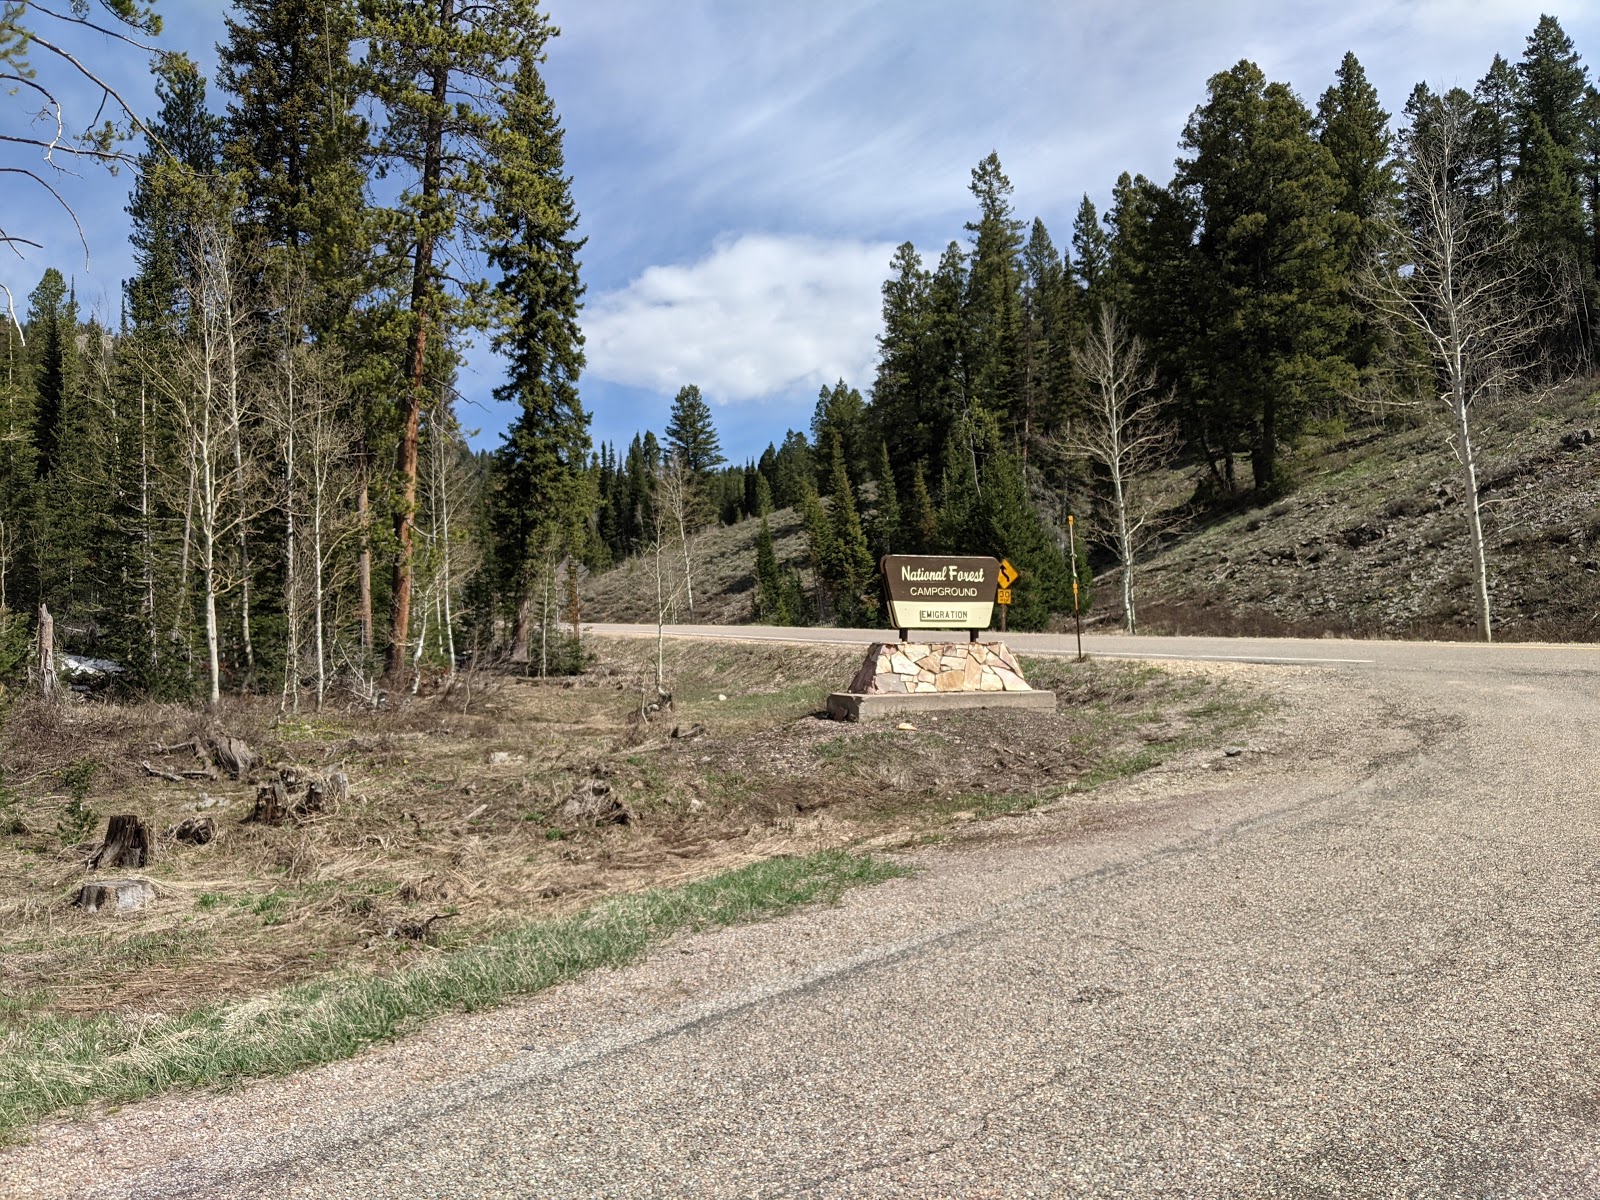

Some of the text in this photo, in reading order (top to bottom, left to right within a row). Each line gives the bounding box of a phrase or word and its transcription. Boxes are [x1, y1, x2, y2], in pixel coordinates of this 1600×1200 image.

[902, 565, 984, 582] National Forest
[910, 587, 977, 597] CAMPGROUND
[921, 610, 967, 619] EMIGRATION
